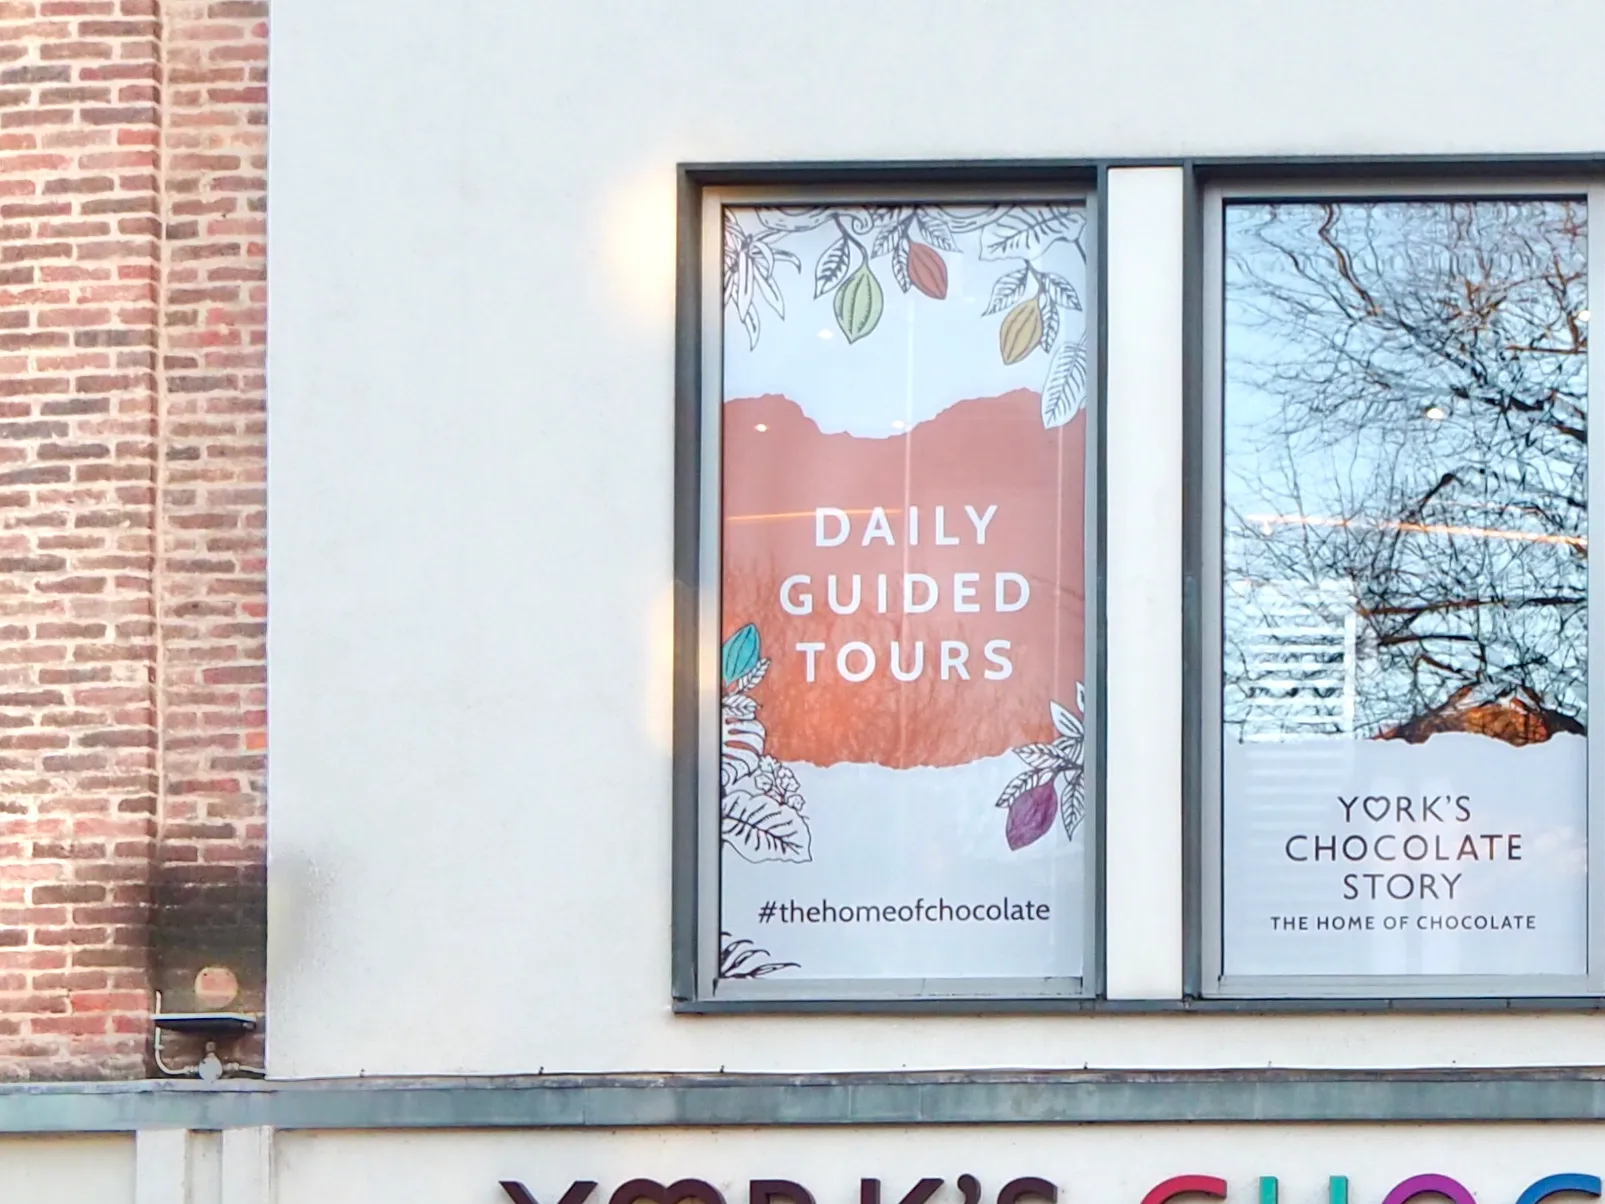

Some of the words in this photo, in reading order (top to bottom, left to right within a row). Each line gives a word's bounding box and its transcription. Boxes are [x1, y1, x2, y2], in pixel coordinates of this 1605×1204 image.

[814, 504, 999, 547] DAILY
[779, 572, 1031, 615] GUIDED
[796, 639, 1014, 683] TOURS
[1284, 833, 1524, 862] CHOCOLATE
[1342, 872, 1464, 902] STORY
[757, 897, 1052, 924] #thehomeofchocolate
[1270, 914, 1312, 931] THE
[1316, 914, 1377, 931] HOME
[1382, 914, 1410, 931] OF
[1415, 914, 1538, 931] CHOCOLATE
